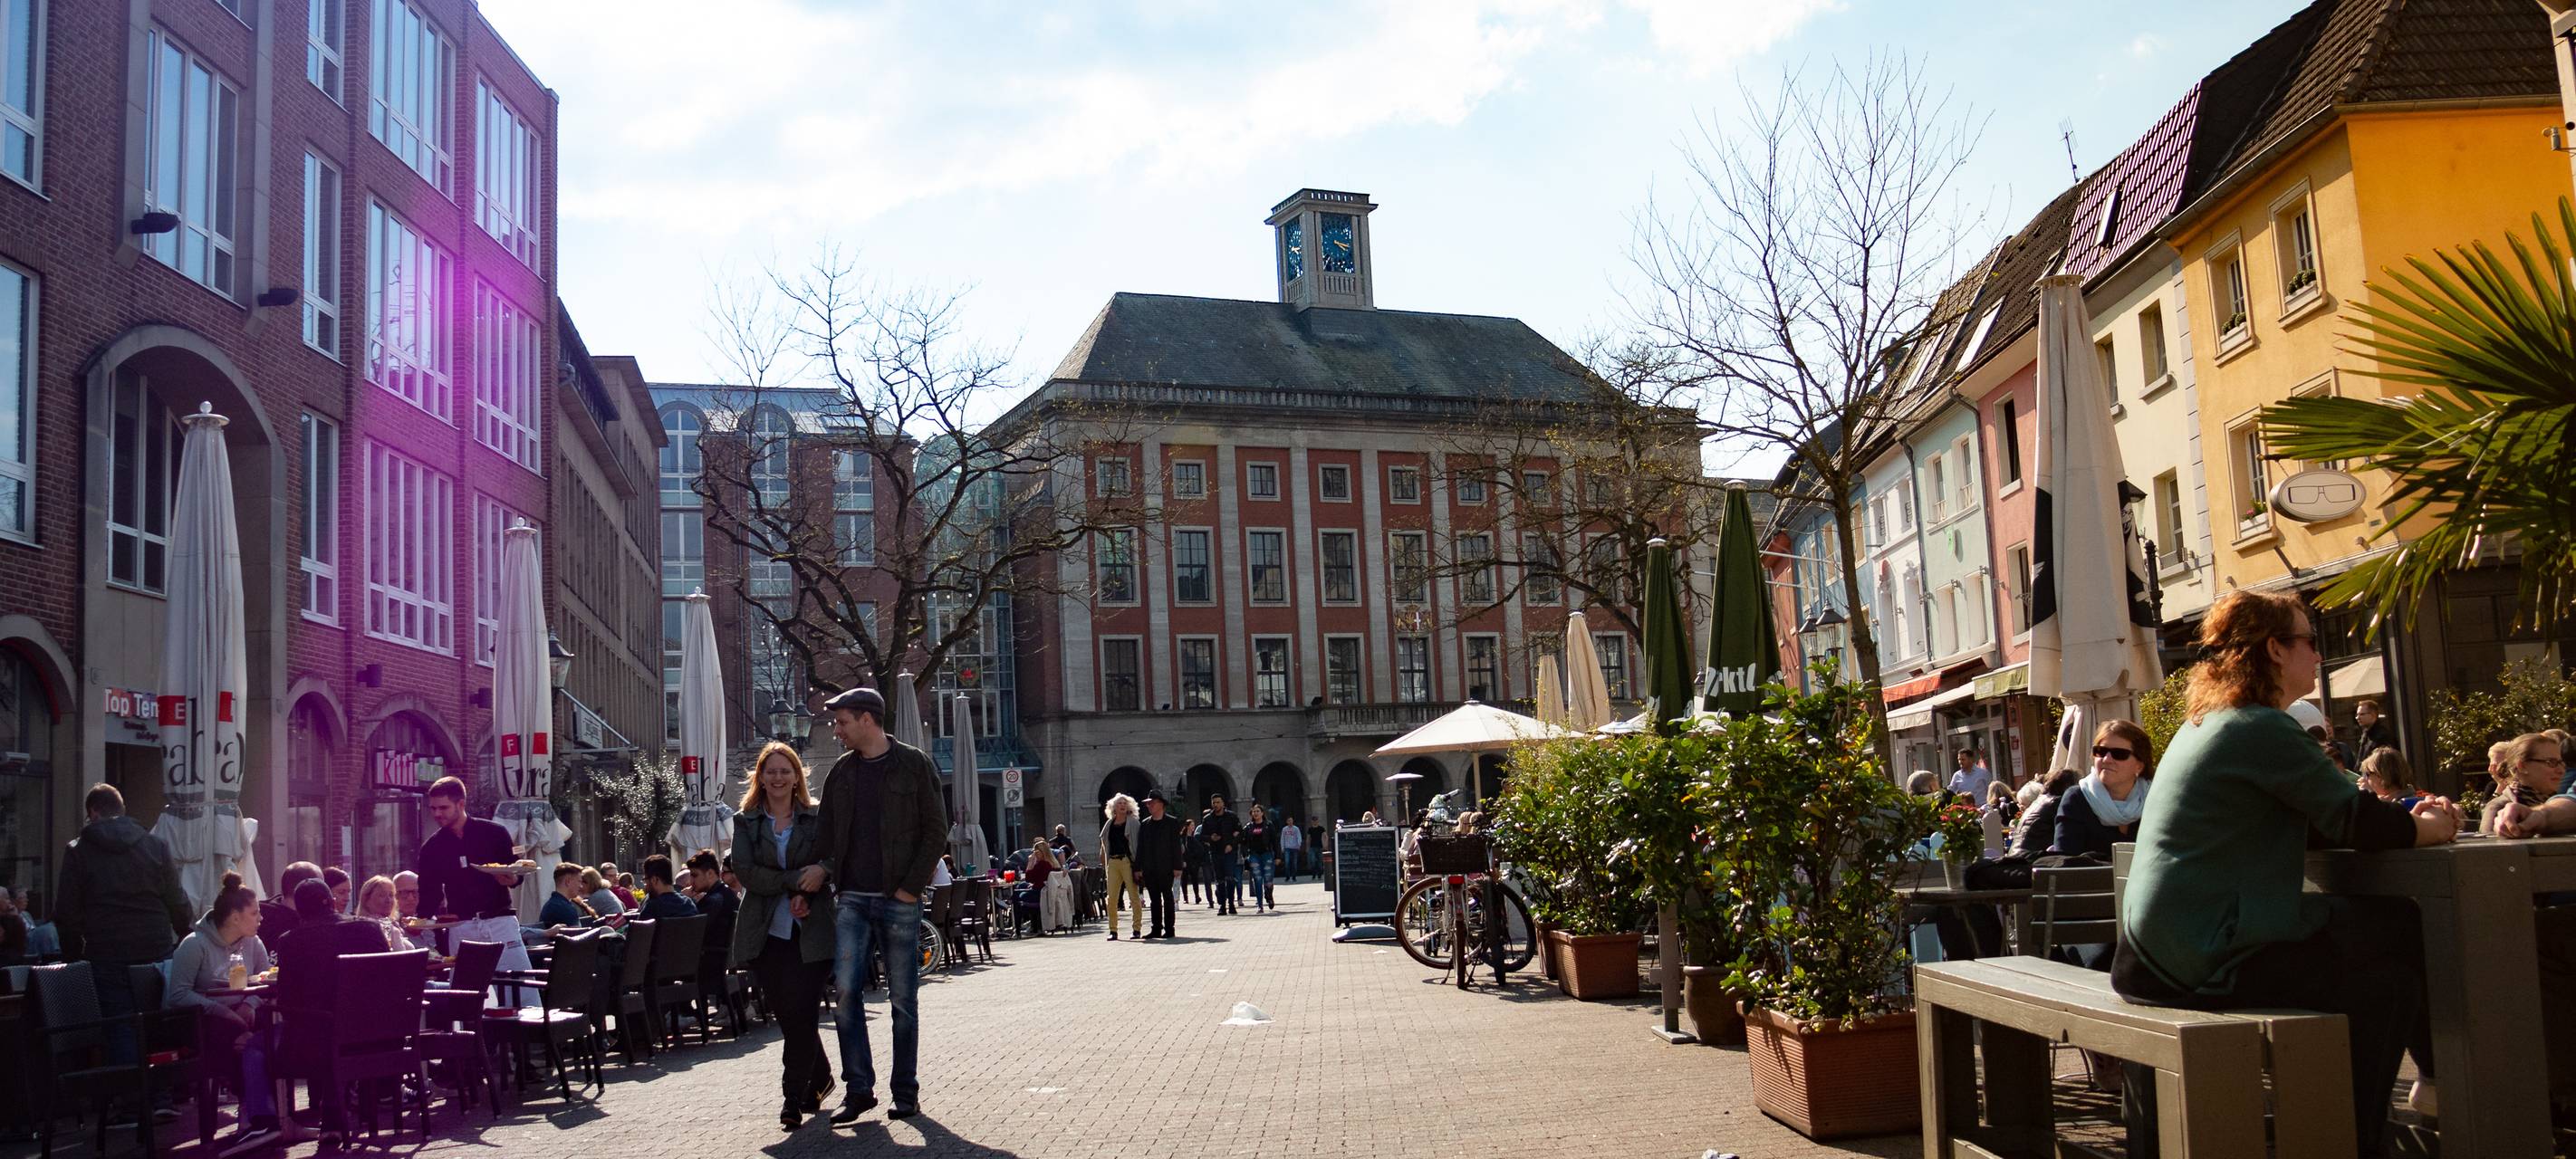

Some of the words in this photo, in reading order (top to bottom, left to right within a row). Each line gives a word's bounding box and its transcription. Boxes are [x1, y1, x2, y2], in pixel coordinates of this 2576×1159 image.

[104, 688, 130, 717] Top
[134, 693, 159, 718] Ten
[506, 739, 514, 752] F
[691, 760, 697, 770] E
